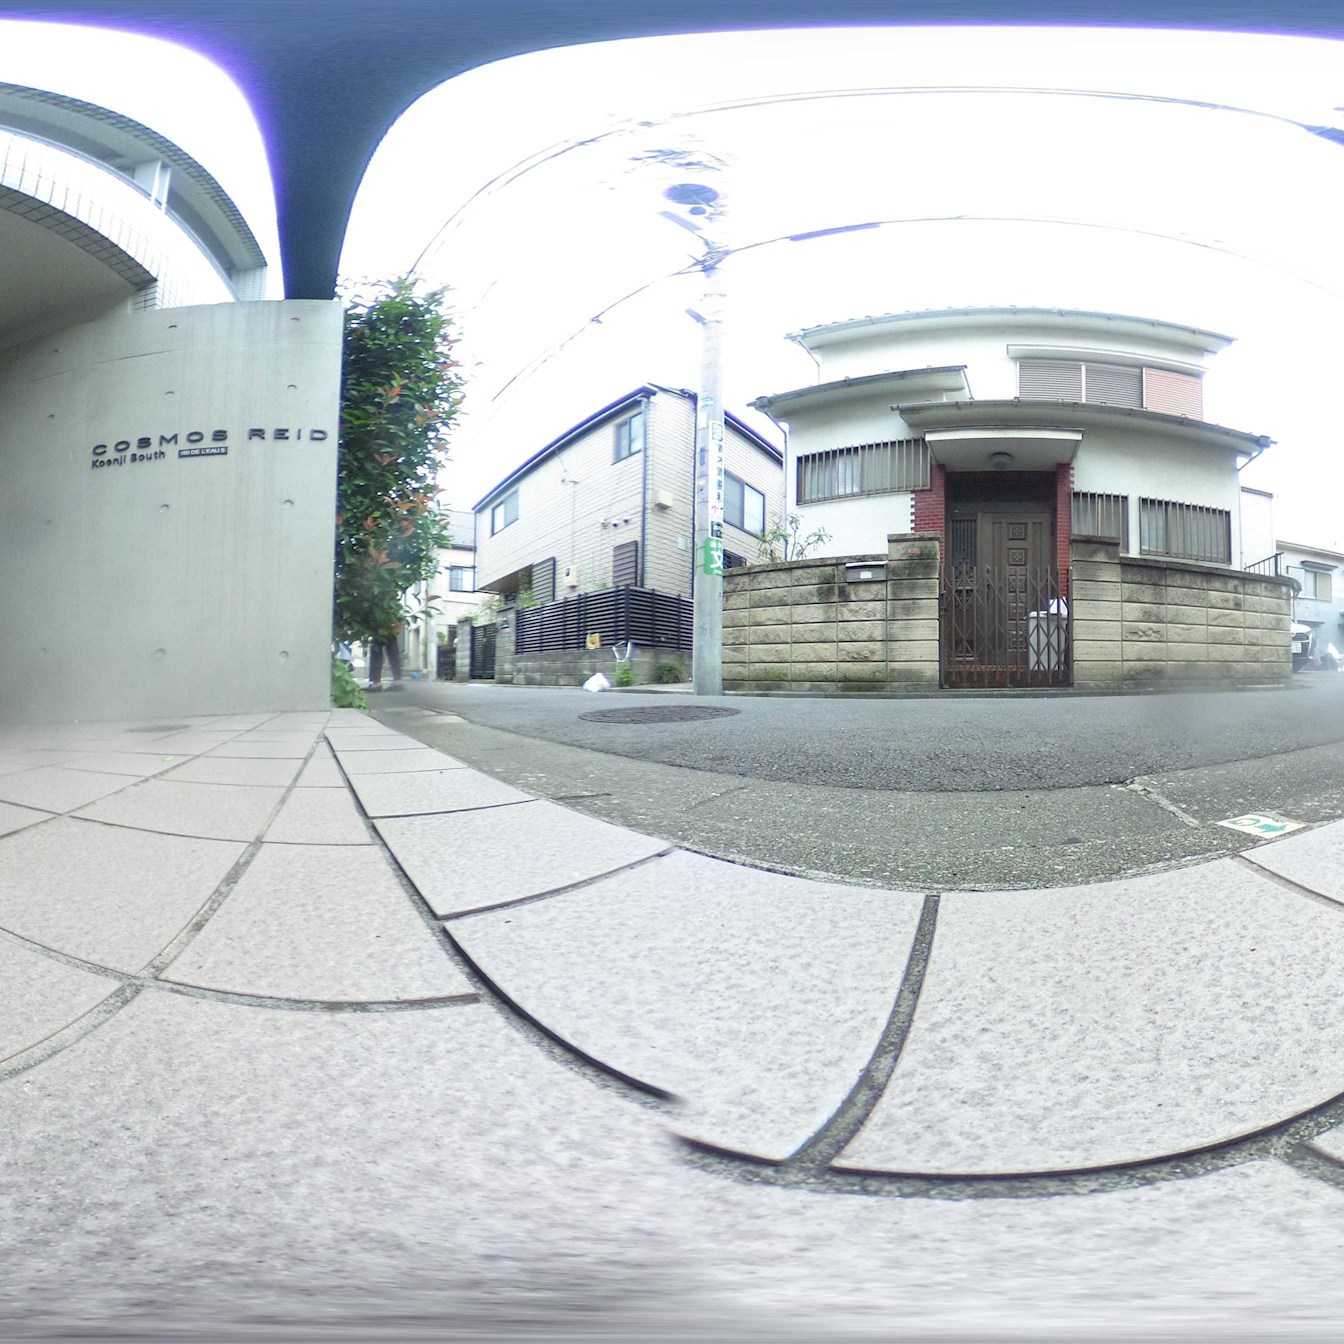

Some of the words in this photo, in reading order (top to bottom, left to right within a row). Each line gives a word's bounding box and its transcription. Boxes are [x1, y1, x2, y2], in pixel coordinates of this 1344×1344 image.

[92, 429, 228, 455] COSMOS
[248, 428, 328, 441] REID
[130, 449, 166, 463] South
